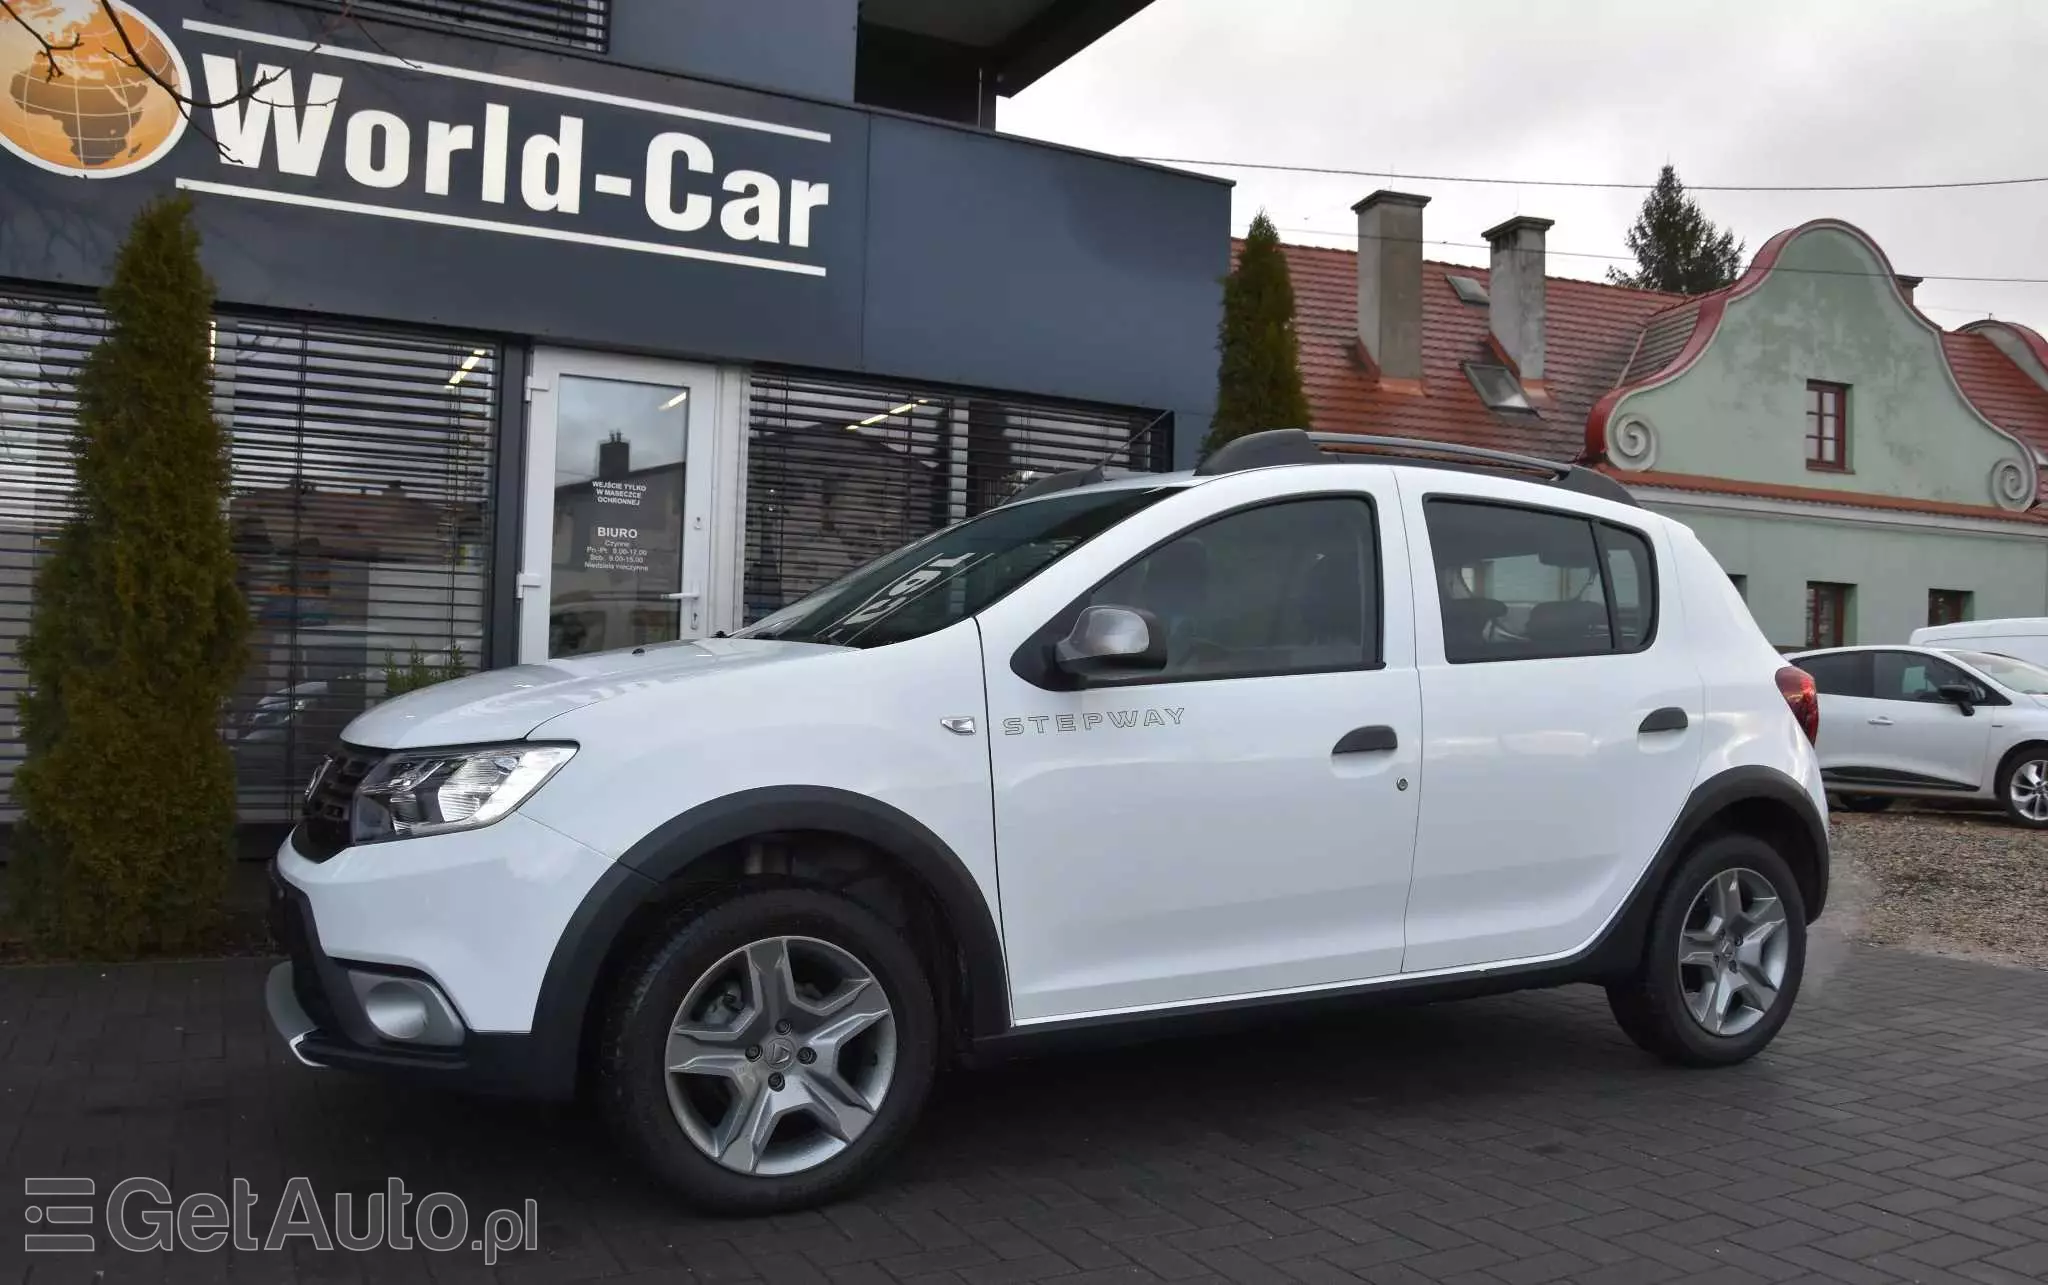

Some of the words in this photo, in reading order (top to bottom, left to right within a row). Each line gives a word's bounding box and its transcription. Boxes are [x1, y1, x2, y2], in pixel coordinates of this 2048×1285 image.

[201, 54, 830, 247] World-Car
[624, 483, 647, 492] TYLKO
[597, 527, 638, 538] BIURO
[1002, 707, 1185, 736] STEPWAY
